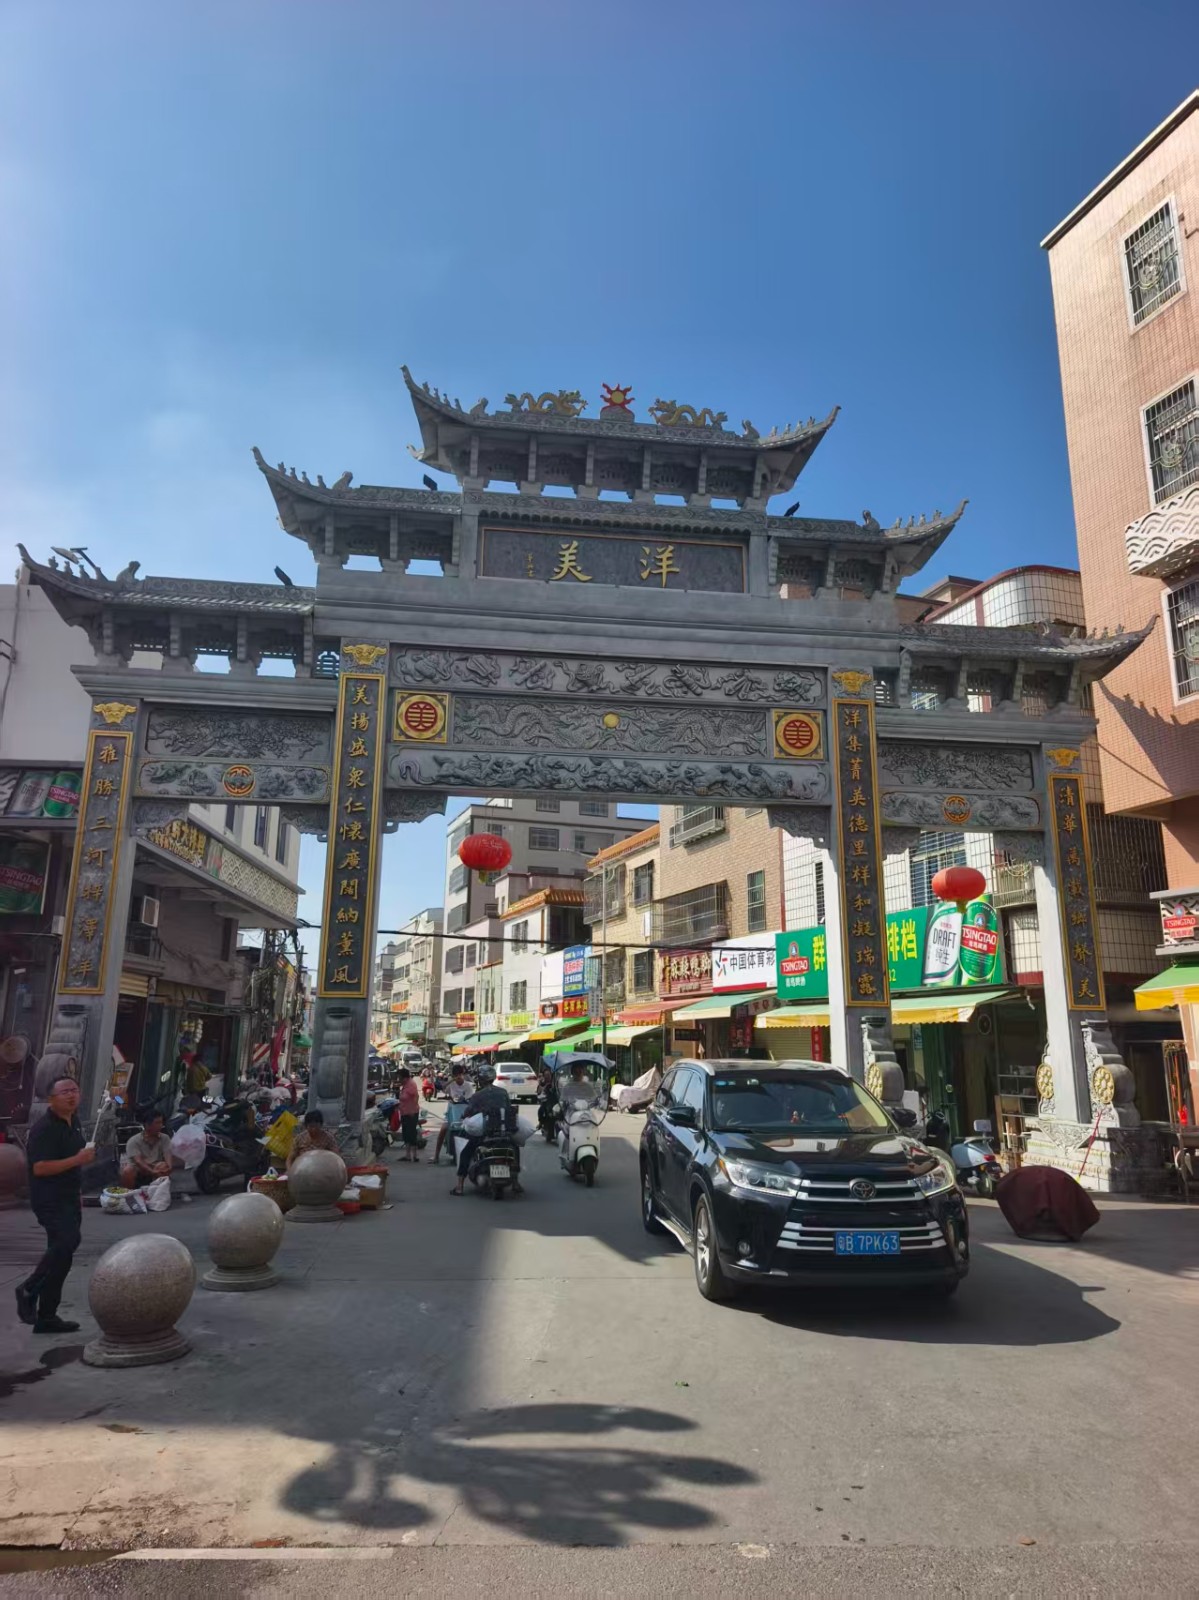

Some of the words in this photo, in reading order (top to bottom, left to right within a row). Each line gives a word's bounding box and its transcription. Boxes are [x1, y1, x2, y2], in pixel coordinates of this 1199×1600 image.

[1166, 917, 1196, 928] TSINGTAO
[932, 927, 957, 949] DRAFT
[962, 926, 997, 945] TSINGTAO
[781, 960, 809, 973] TSINGTAO
